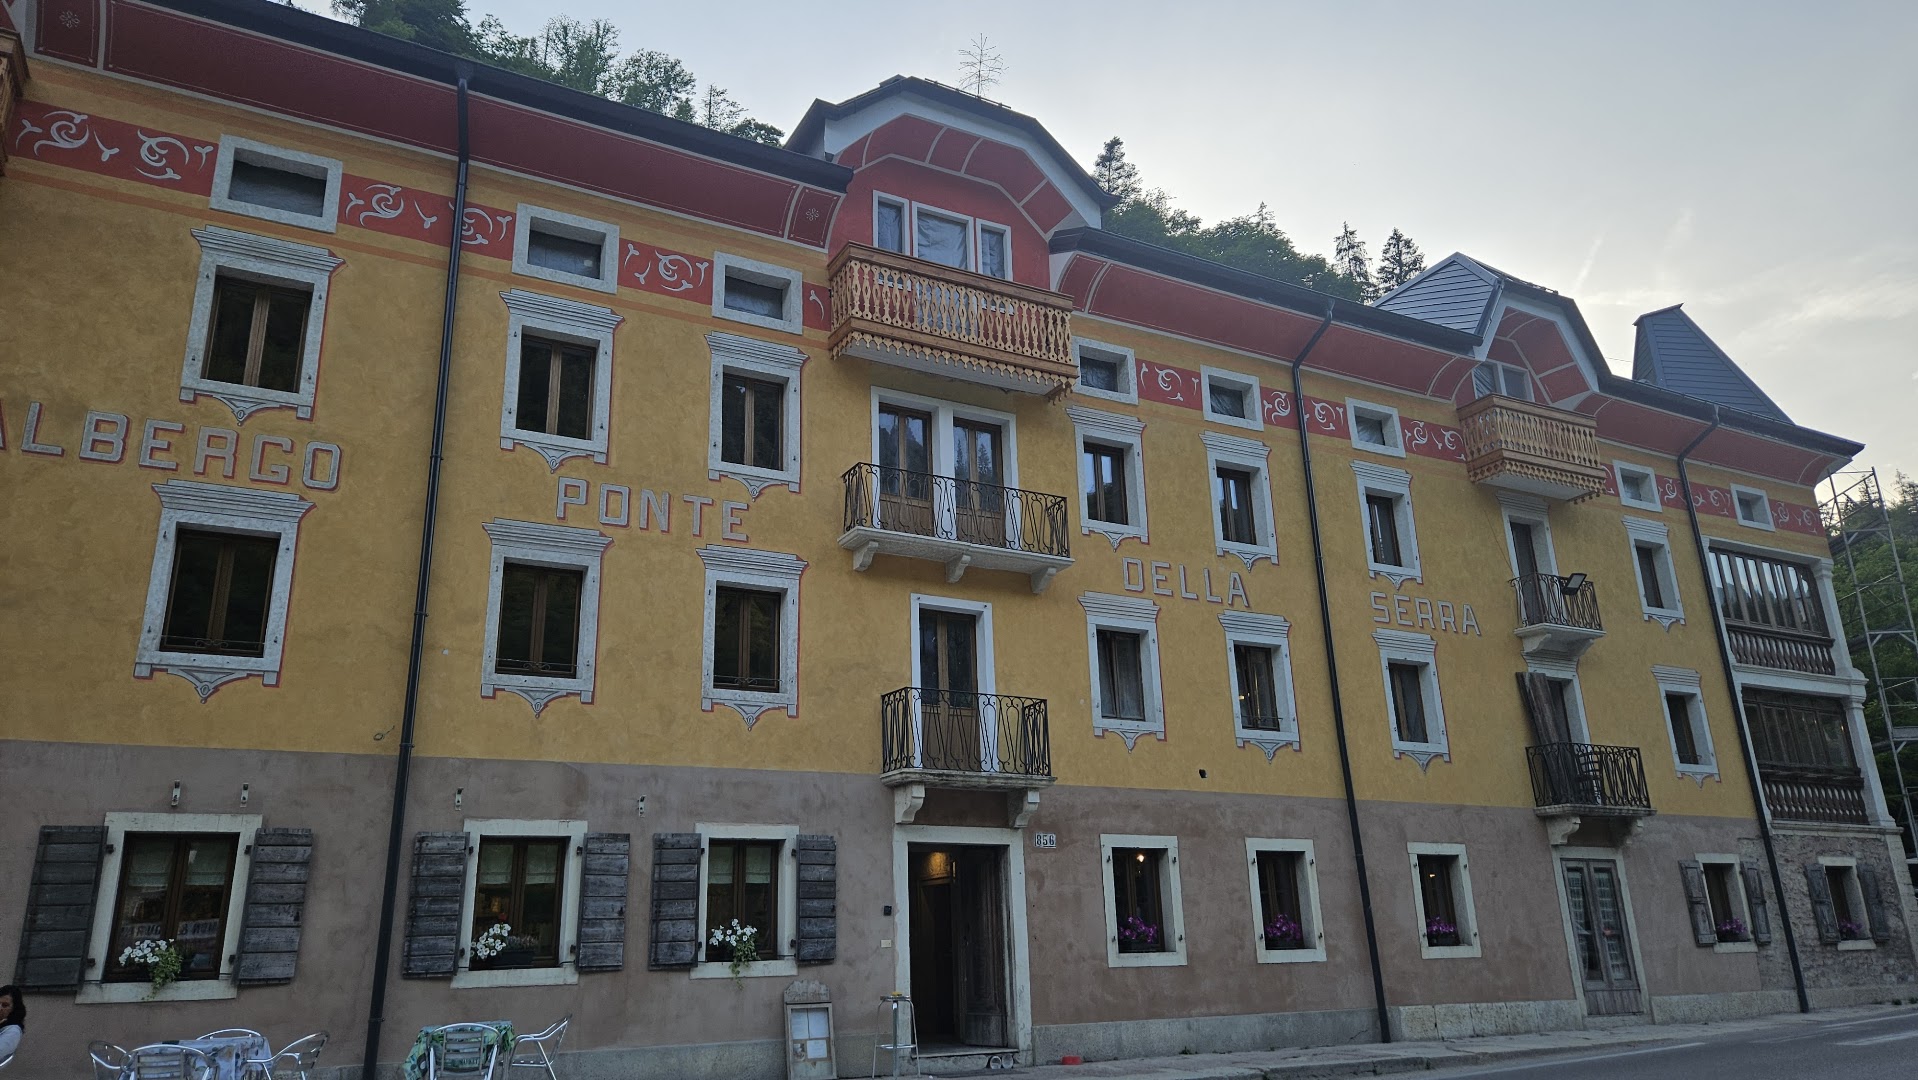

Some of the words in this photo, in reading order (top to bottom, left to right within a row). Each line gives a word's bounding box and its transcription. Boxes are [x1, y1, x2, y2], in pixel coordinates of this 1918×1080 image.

[0, 400, 341, 491] LBERGO
[556, 476, 749, 542] PONTE
[1122, 557, 1250, 607] DELLA
[1370, 591, 1481, 636] SERRA
[1036, 834, 1055, 846] 856
